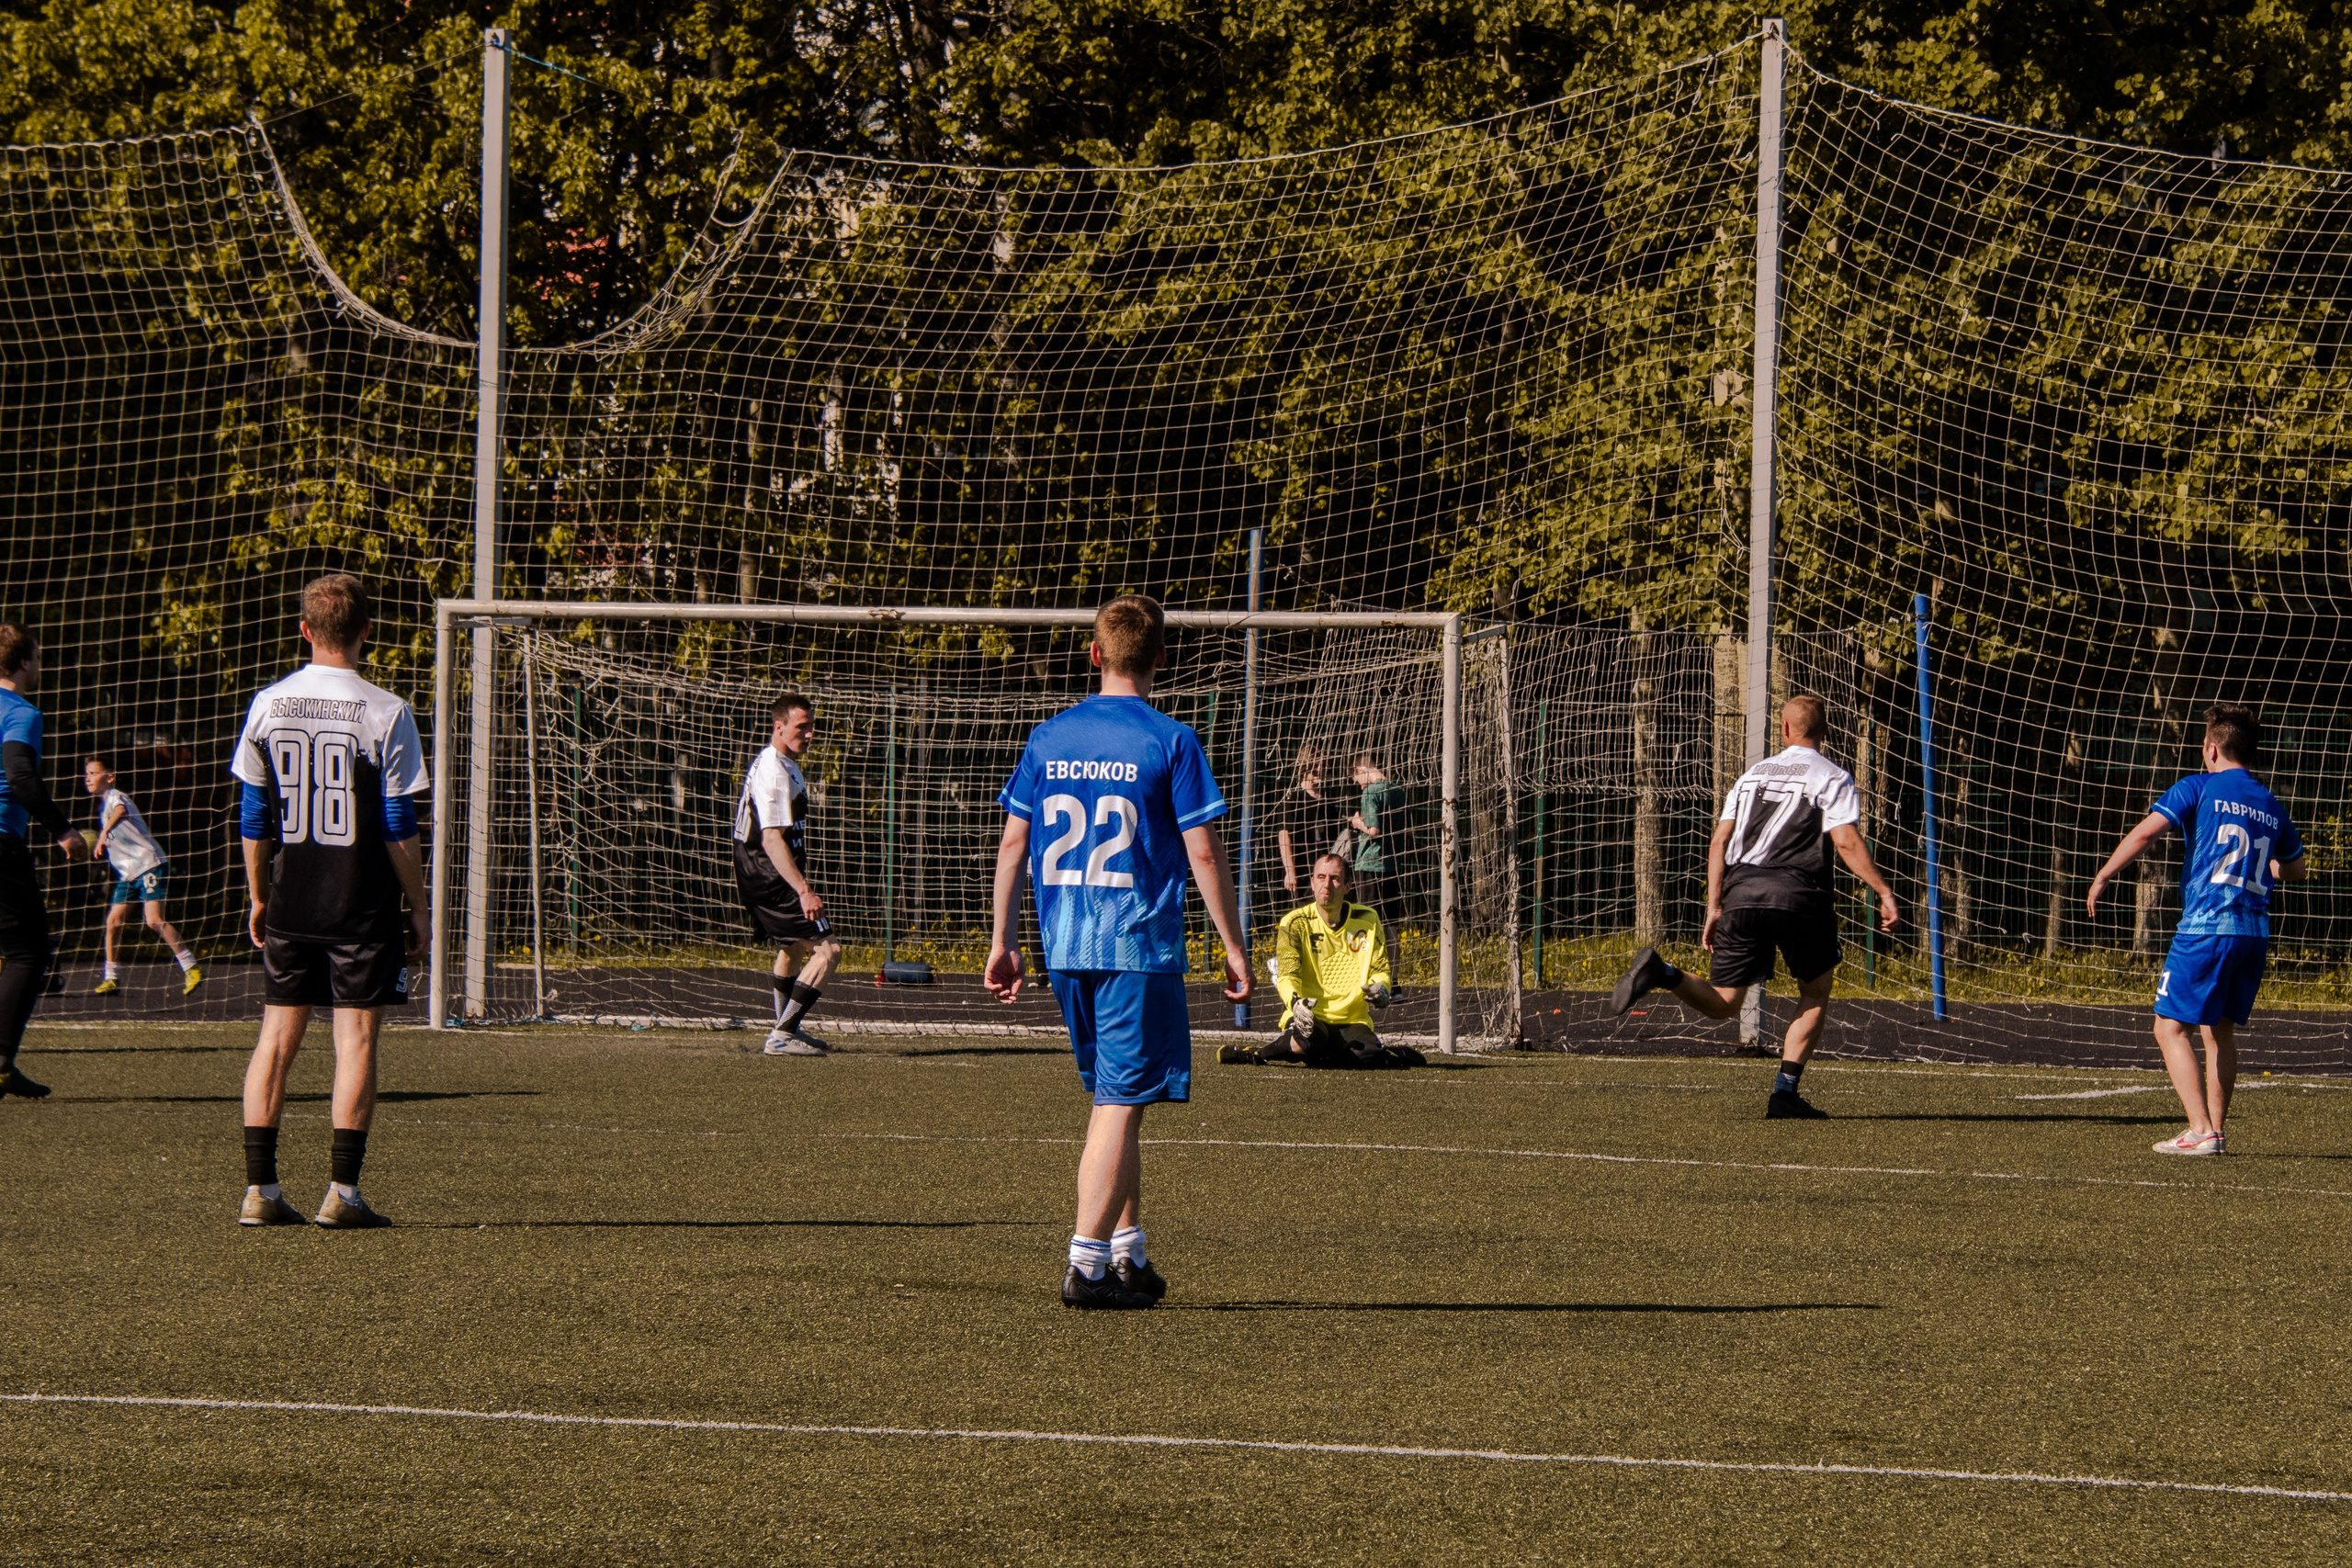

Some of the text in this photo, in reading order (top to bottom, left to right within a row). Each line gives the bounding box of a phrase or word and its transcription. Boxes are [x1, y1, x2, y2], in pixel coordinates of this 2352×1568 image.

[269, 696, 368, 723] ВЫСОКИНСКИЙ
[268, 728, 359, 847] 98
[1046, 760, 1138, 783] ЕВСЮКОВ
[1042, 794, 1138, 888] 22
[1724, 780, 1807, 866] 17
[2214, 799, 2278, 830] ГАВРИЛОВ
[2211, 823, 2271, 897] 21
